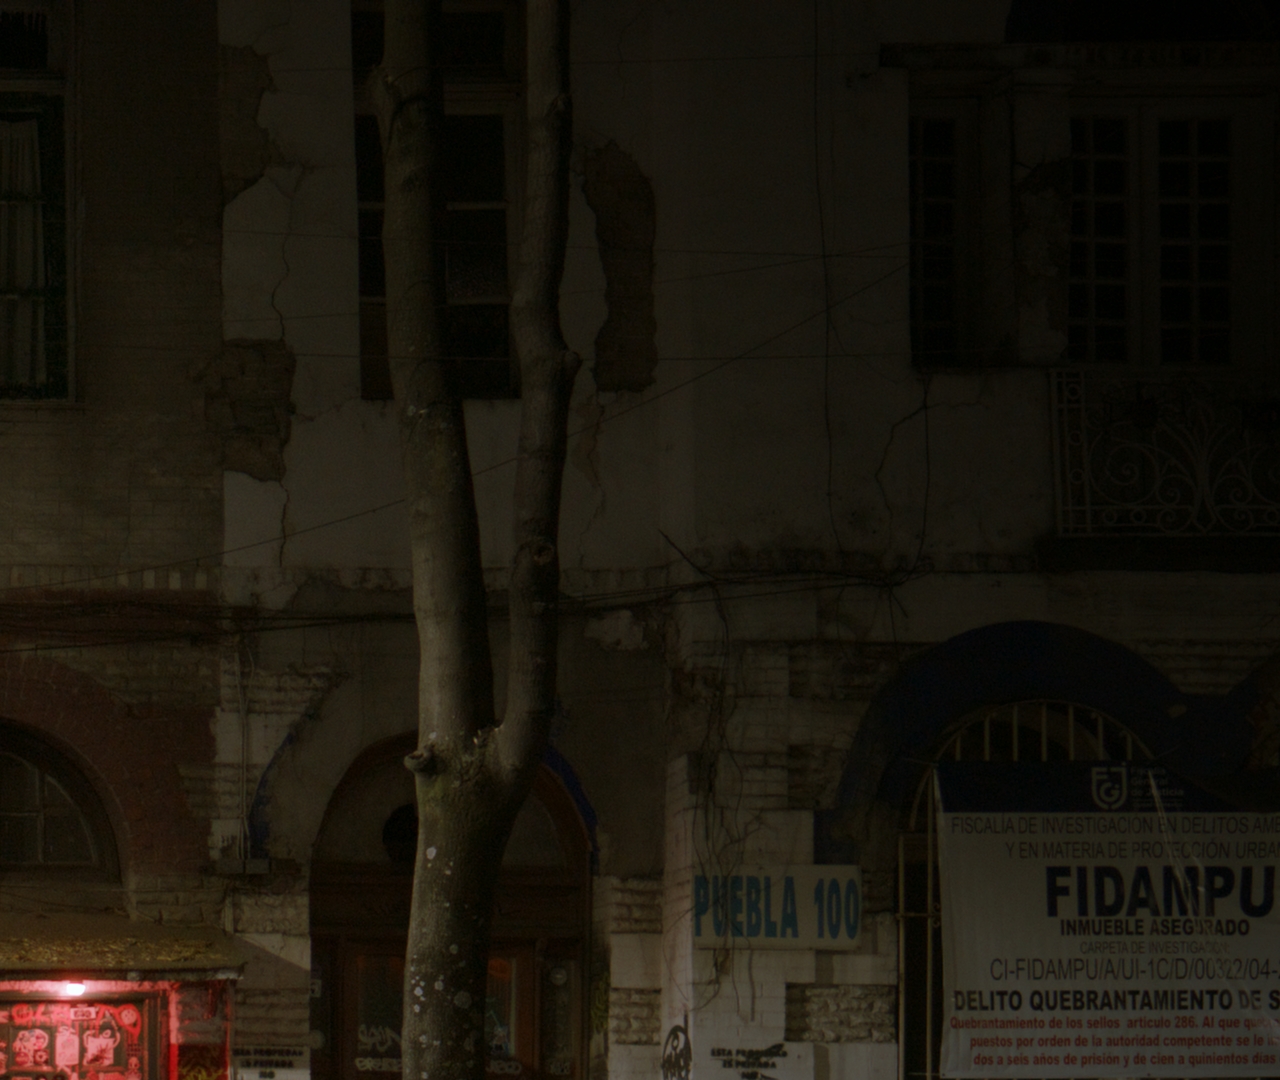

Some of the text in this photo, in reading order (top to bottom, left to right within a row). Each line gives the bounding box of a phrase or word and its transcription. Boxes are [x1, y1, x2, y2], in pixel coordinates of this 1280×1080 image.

[951, 813, 1015, 834] FISCALÍA
[1018, 816, 1037, 834] DE
[1182, 815, 1249, 834] DELITOS
[1005, 841, 1015, 859] Y
[1019, 841, 1038, 859] EN
[1043, 841, 1105, 859] MATERIA
[1108, 842, 1127, 859] DE
[694, 875, 859, 940] PUEBLA 100
[1060, 918, 1251, 936] INMUEBLE ASEGURADO
[1079, 940, 1130, 954] CARPETA
[1129, 940, 1145, 954] DE
[953, 989, 1023, 1011] DELITO
[1029, 989, 1233, 1012] QUEBRANTAMIENTO
[949, 1015, 1046, 1029] Quebrantamiento
[1048, 1016, 1063, 1029] de
[1066, 1016, 1083, 1029] los
[1087, 1016, 1121, 1029] sellos
[1202, 1016, 1215, 1029] Al
[1218, 1018, 1241, 1031] que
[970, 1036, 1013, 1050] puestos
[1016, 1037, 1034, 1050] por
[1037, 1035, 1071, 1047] orden
[1074, 1035, 1088, 1047] de
[1092, 1035, 1102, 1047] la
[1106, 1034, 1160, 1047] autoridad
[1163, 1035, 1233, 1050] competente
[1236, 1036, 1250, 1046] se
[1253, 1033, 1264, 1046] le
[973, 1052, 994, 1066] dos
[997, 1056, 1004, 1065] a
[1007, 1053, 1029, 1065] seis
[1033, 1052, 1060, 1065] años
[1063, 1053, 1077, 1065] de
[1123, 1056, 1130, 1068] y
[1133, 1053, 1147, 1065] de
[1150, 1053, 1175, 1065] cien
[1177, 1056, 1185, 1065] a
[1188, 1053, 1249, 1067] quinientos
